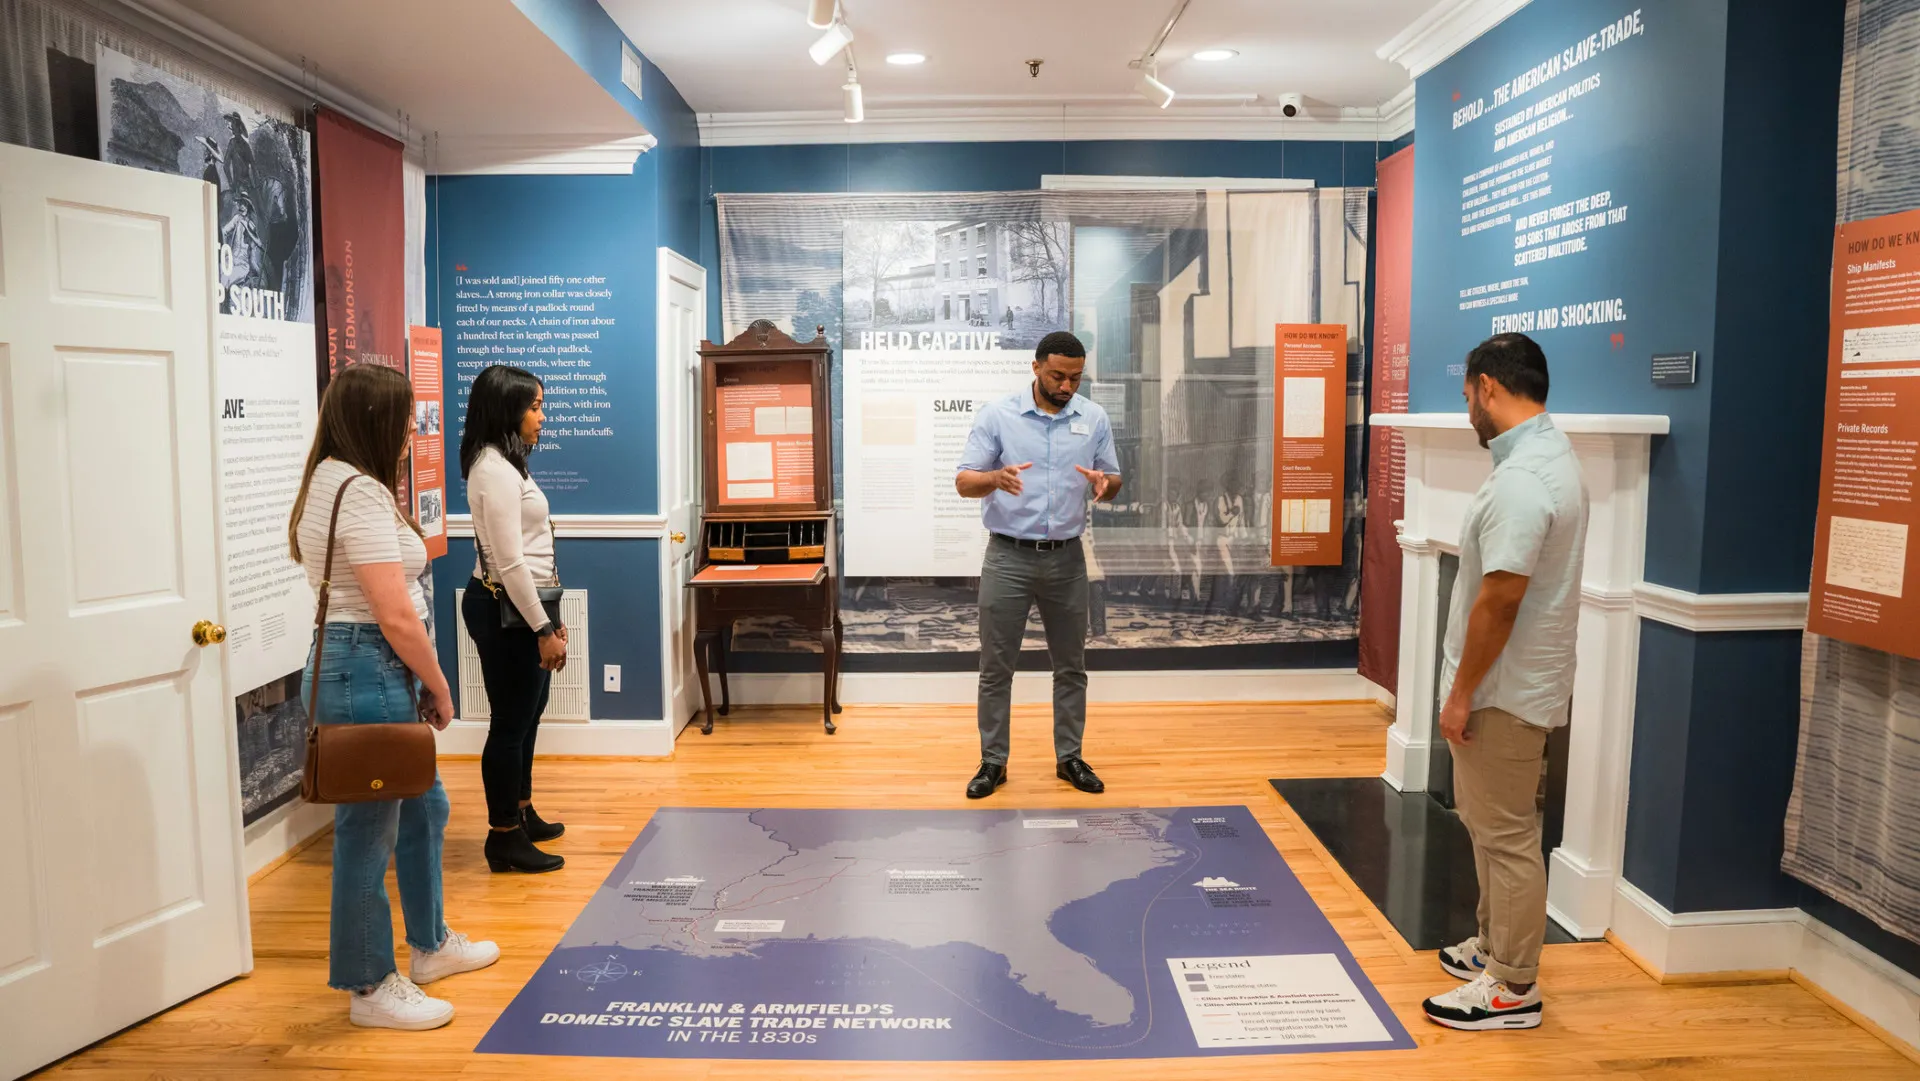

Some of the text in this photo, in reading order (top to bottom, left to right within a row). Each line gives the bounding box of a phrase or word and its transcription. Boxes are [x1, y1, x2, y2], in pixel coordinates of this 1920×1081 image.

[1453, 98, 1483, 130] BEHOLD
[1511, 54, 1560, 100] AMERICAN
[1563, 8, 1644, 71] SLAVE-TRADE,
[1495, 73, 1600, 136] SUSTAINED BY AMERICAN POLITICS
[1494, 137, 1506, 152] AND
[1507, 121, 1536, 147] AMERICAN
[1516, 191, 1612, 231] AND NEVER FORGET THE DEEP,
[1515, 206, 1627, 249] SAD SOBS THAT AROSE FROM THAT
[1849, 234, 1902, 254] HOW DO WE
[1514, 237, 1587, 266] SCATTERED MULTITUDE.
[1848, 259, 1895, 274] Ship Manifests
[483, 276, 499, 284] sold
[521, 276, 546, 285] joined
[549, 275, 564, 286] fifty
[583, 276, 606, 284] other
[345, 240, 355, 352] EDMONSON
[496, 291, 522, 300] strong
[543, 290, 565, 298] collar
[585, 289, 612, 299] closely
[230, 285, 284, 320] SOUTH
[457, 304, 477, 312] fitted
[480, 304, 489, 314] by
[536, 304, 568, 313] padlock
[570, 303, 594, 311] round
[457, 318, 474, 326] each
[477, 318, 485, 326] of
[503, 317, 527, 325] necks.
[530, 317, 536, 325] A
[539, 317, 560, 325] chain
[563, 317, 572, 325] of
[573, 317, 589, 325] iron
[591, 317, 615, 325] about
[1492, 298, 1626, 335] FIENDISH AND SHOCKING.
[464, 331, 497, 340] hundred
[500, 331, 514, 339] feet
[517, 331, 524, 339] in
[526, 331, 552, 341] length
[572, 331, 599, 340] passed
[861, 331, 1002, 350] HELD CAPTIVE
[457, 346, 489, 355] through
[506, 345, 525, 355] hasp
[527, 345, 537, 353] of
[537, 345, 555, 353] each
[558, 345, 592, 355] padlock,
[457, 360, 483, 370] except
[527, 359, 549, 368] ends,
[551, 359, 575, 367] where
[578, 359, 590, 367] the
[544, 373, 606, 383] passed through
[590, 387, 607, 396] this,
[550, 401, 571, 410] pairs,
[934, 400, 972, 412] SLAVE
[579, 414, 600, 422] chain
[559, 427, 613, 436] the handcuffs
[1838, 423, 1888, 434] Private Records
[540, 442, 561, 451] pairs.
[1378, 445, 1389, 497] PHILLIS
[1182, 960, 1251, 970] Legend
[606, 1002, 894, 1014] FRANKLIN & ARMFIELD'S
[540, 1013, 952, 1029] DOMESTIC SLAVE TRADE NETWORK
[667, 1031, 817, 1044] IN THE 1830s
